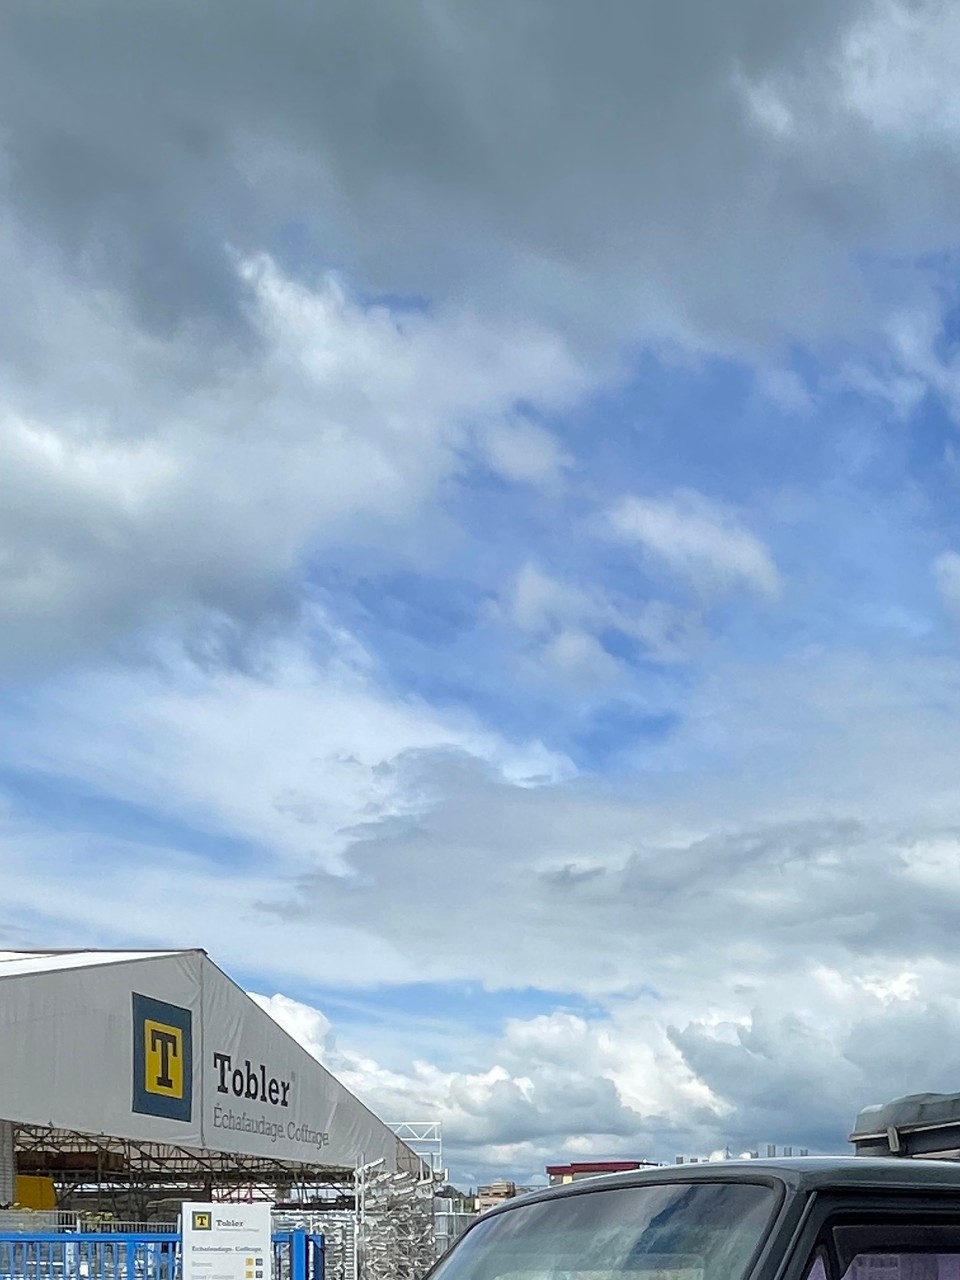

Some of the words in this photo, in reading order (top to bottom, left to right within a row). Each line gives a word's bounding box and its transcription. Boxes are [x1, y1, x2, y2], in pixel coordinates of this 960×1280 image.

[151, 1029, 177, 1088] T
[213, 1052, 290, 1107] Tobler
[216, 1219, 244, 1227] Tobler
